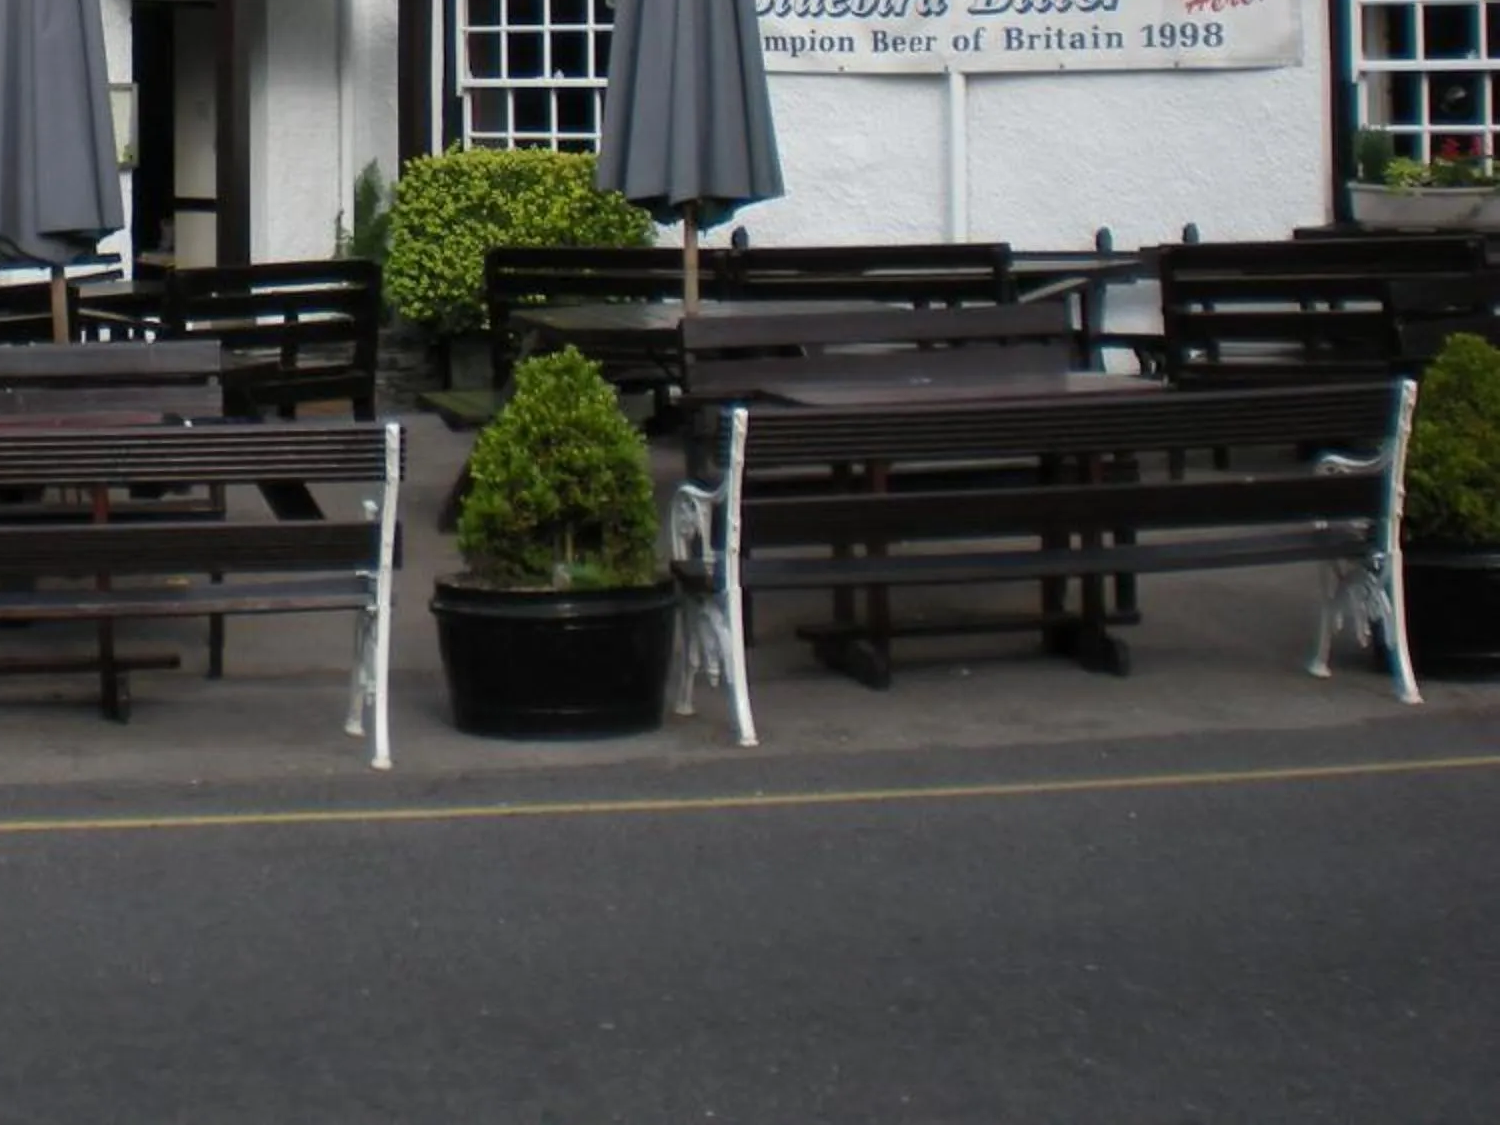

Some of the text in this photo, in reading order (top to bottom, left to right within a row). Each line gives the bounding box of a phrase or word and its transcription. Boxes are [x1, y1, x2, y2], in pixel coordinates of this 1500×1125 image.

[763, 22, 1225, 58] mpion Beer of Britain 1998
